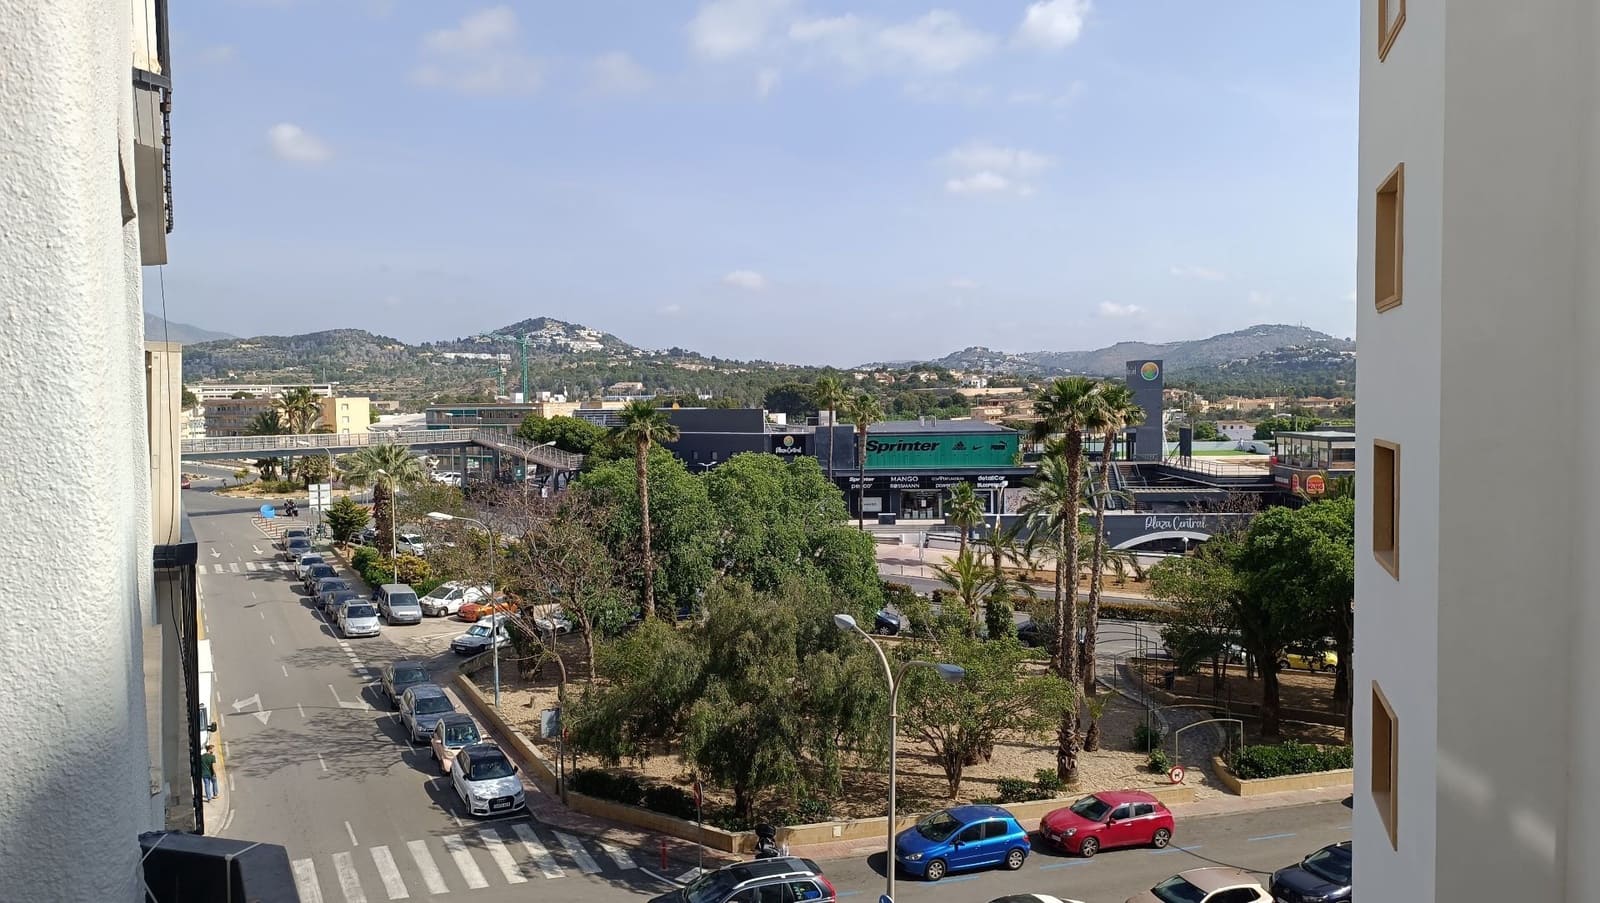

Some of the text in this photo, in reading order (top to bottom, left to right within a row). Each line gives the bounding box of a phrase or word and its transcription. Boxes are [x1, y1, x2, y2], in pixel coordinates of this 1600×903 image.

[866, 440, 940, 454] Sprinter
[1145, 516, 1207, 531] Plaza Central
